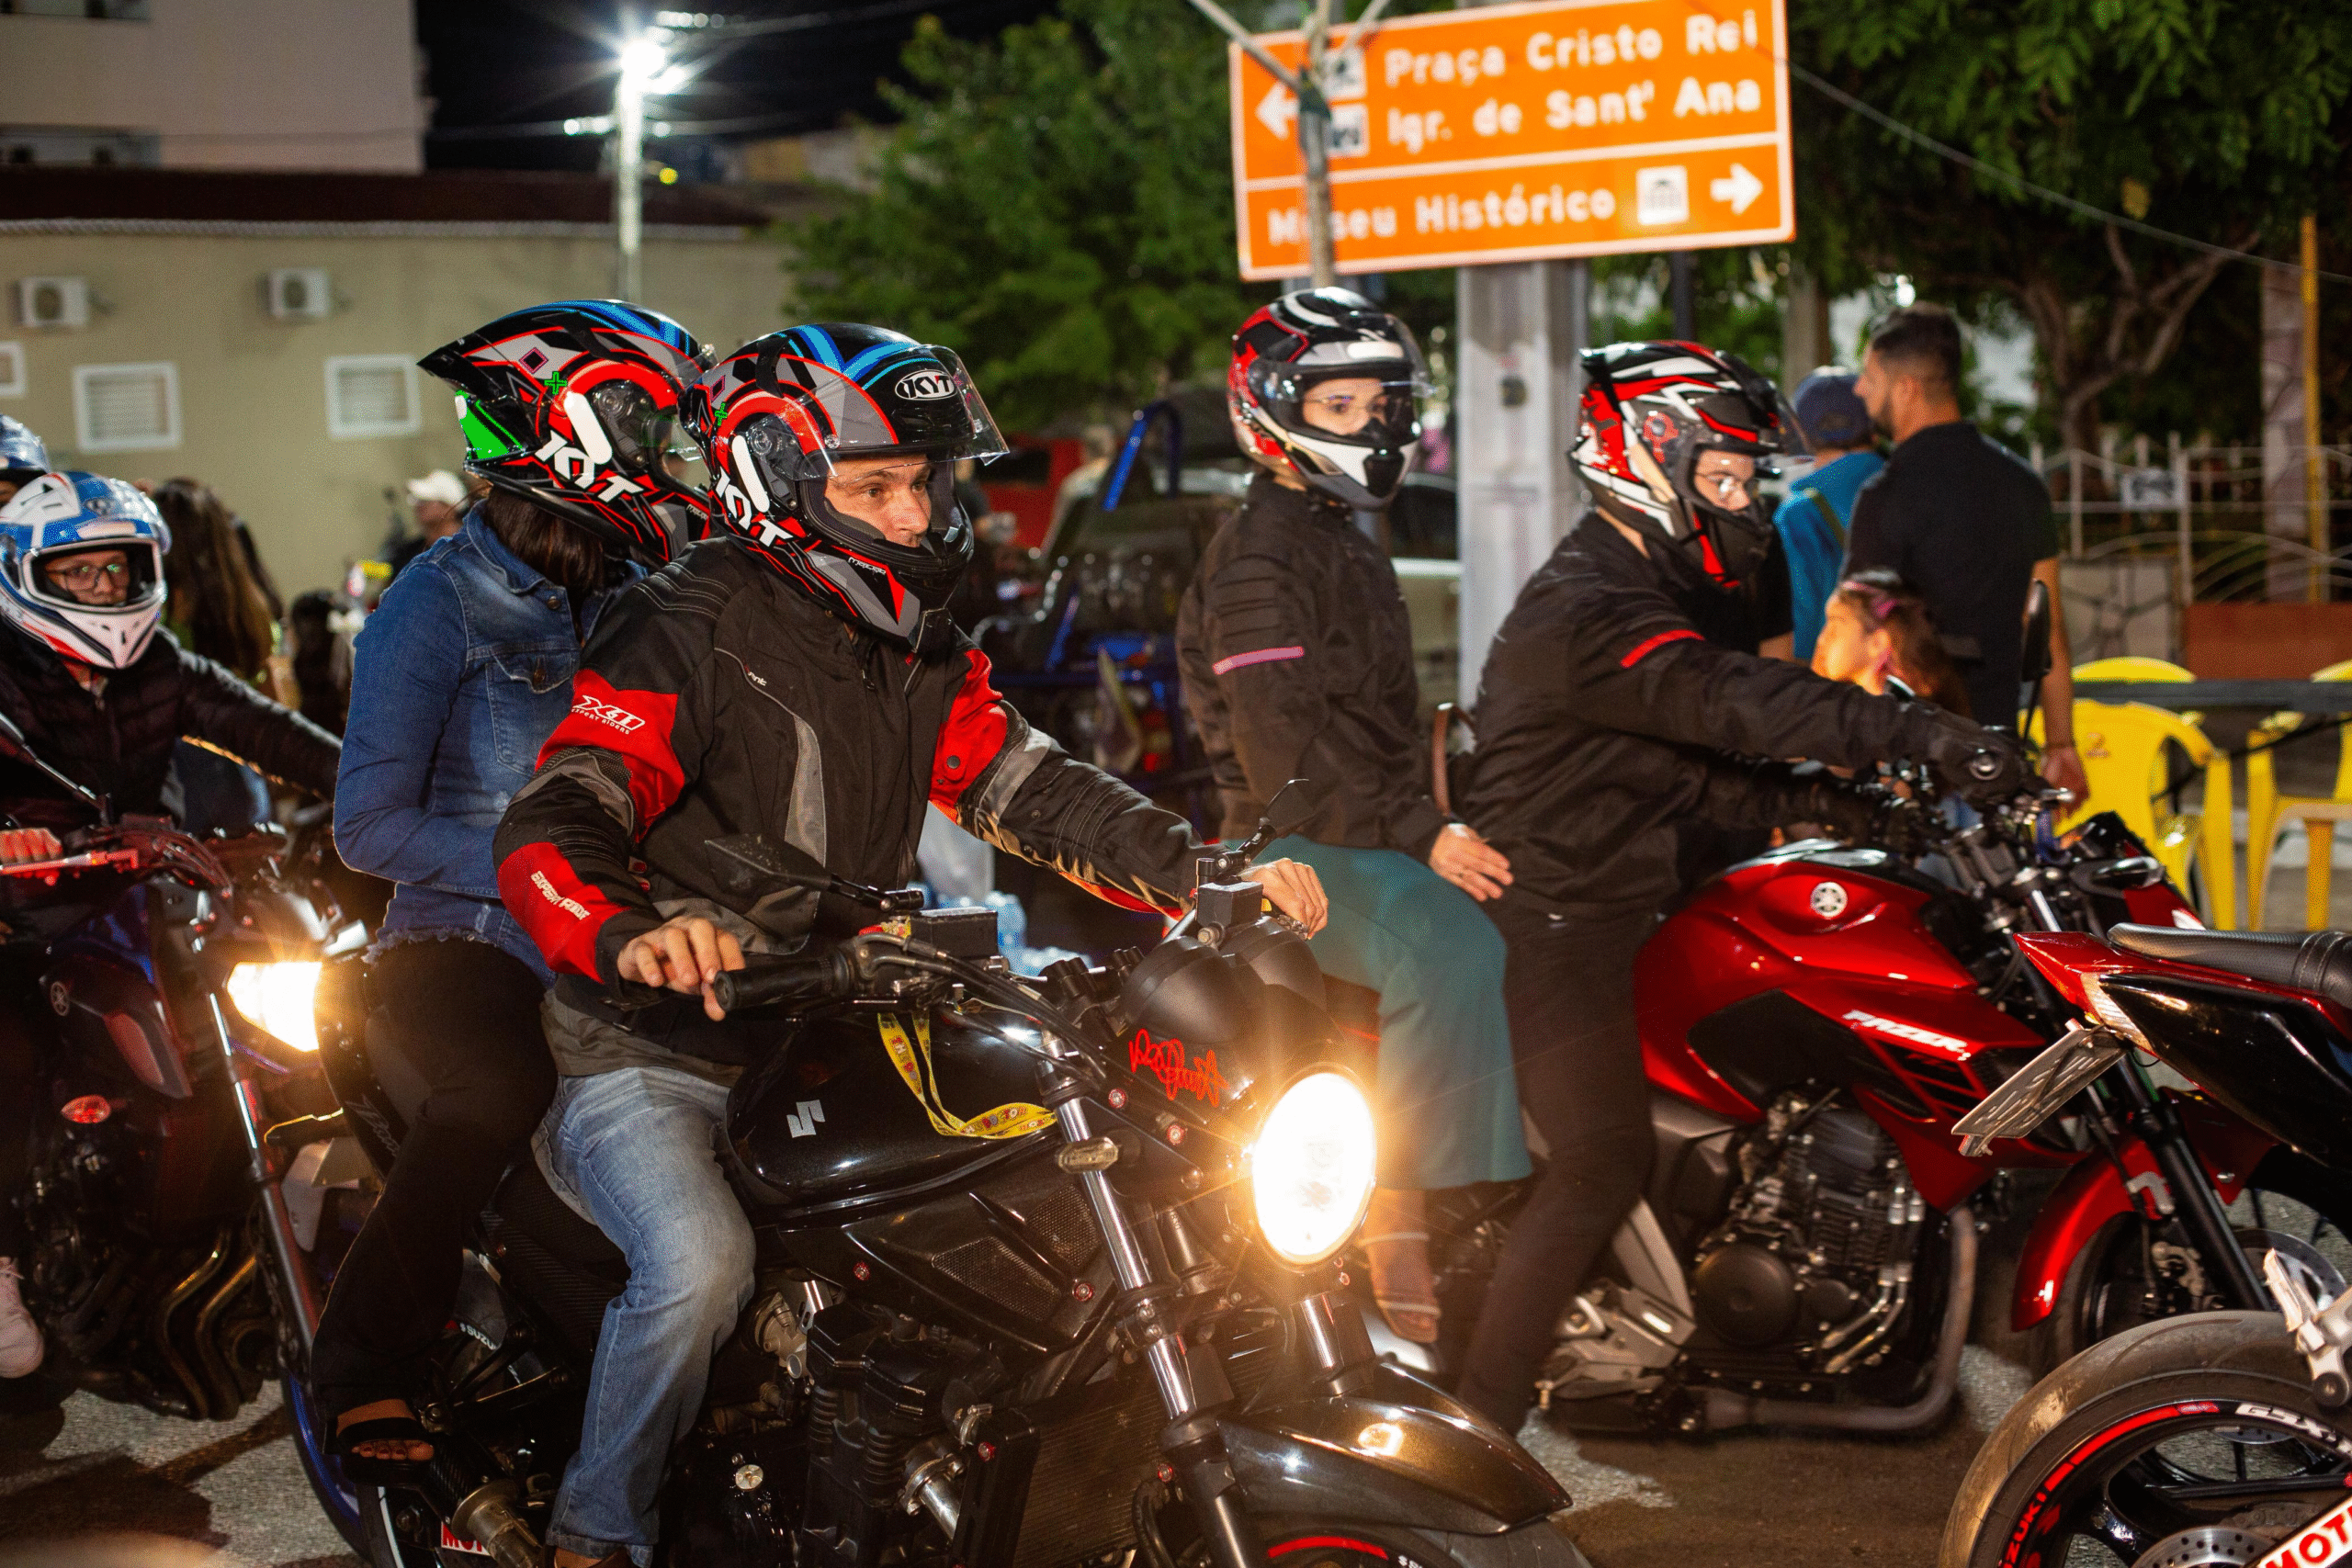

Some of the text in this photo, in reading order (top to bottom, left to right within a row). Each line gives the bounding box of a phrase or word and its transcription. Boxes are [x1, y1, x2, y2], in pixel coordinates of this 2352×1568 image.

[1385, 10, 1758, 86] Praça Cristo Rei
[1387, 107, 1453, 153] Igr.
[1473, 98, 1521, 136] de
[1674, 76, 1761, 118] Ana
[1268, 183, 1616, 246] Mseu Histórico
[899, 375, 952, 400] KYT
